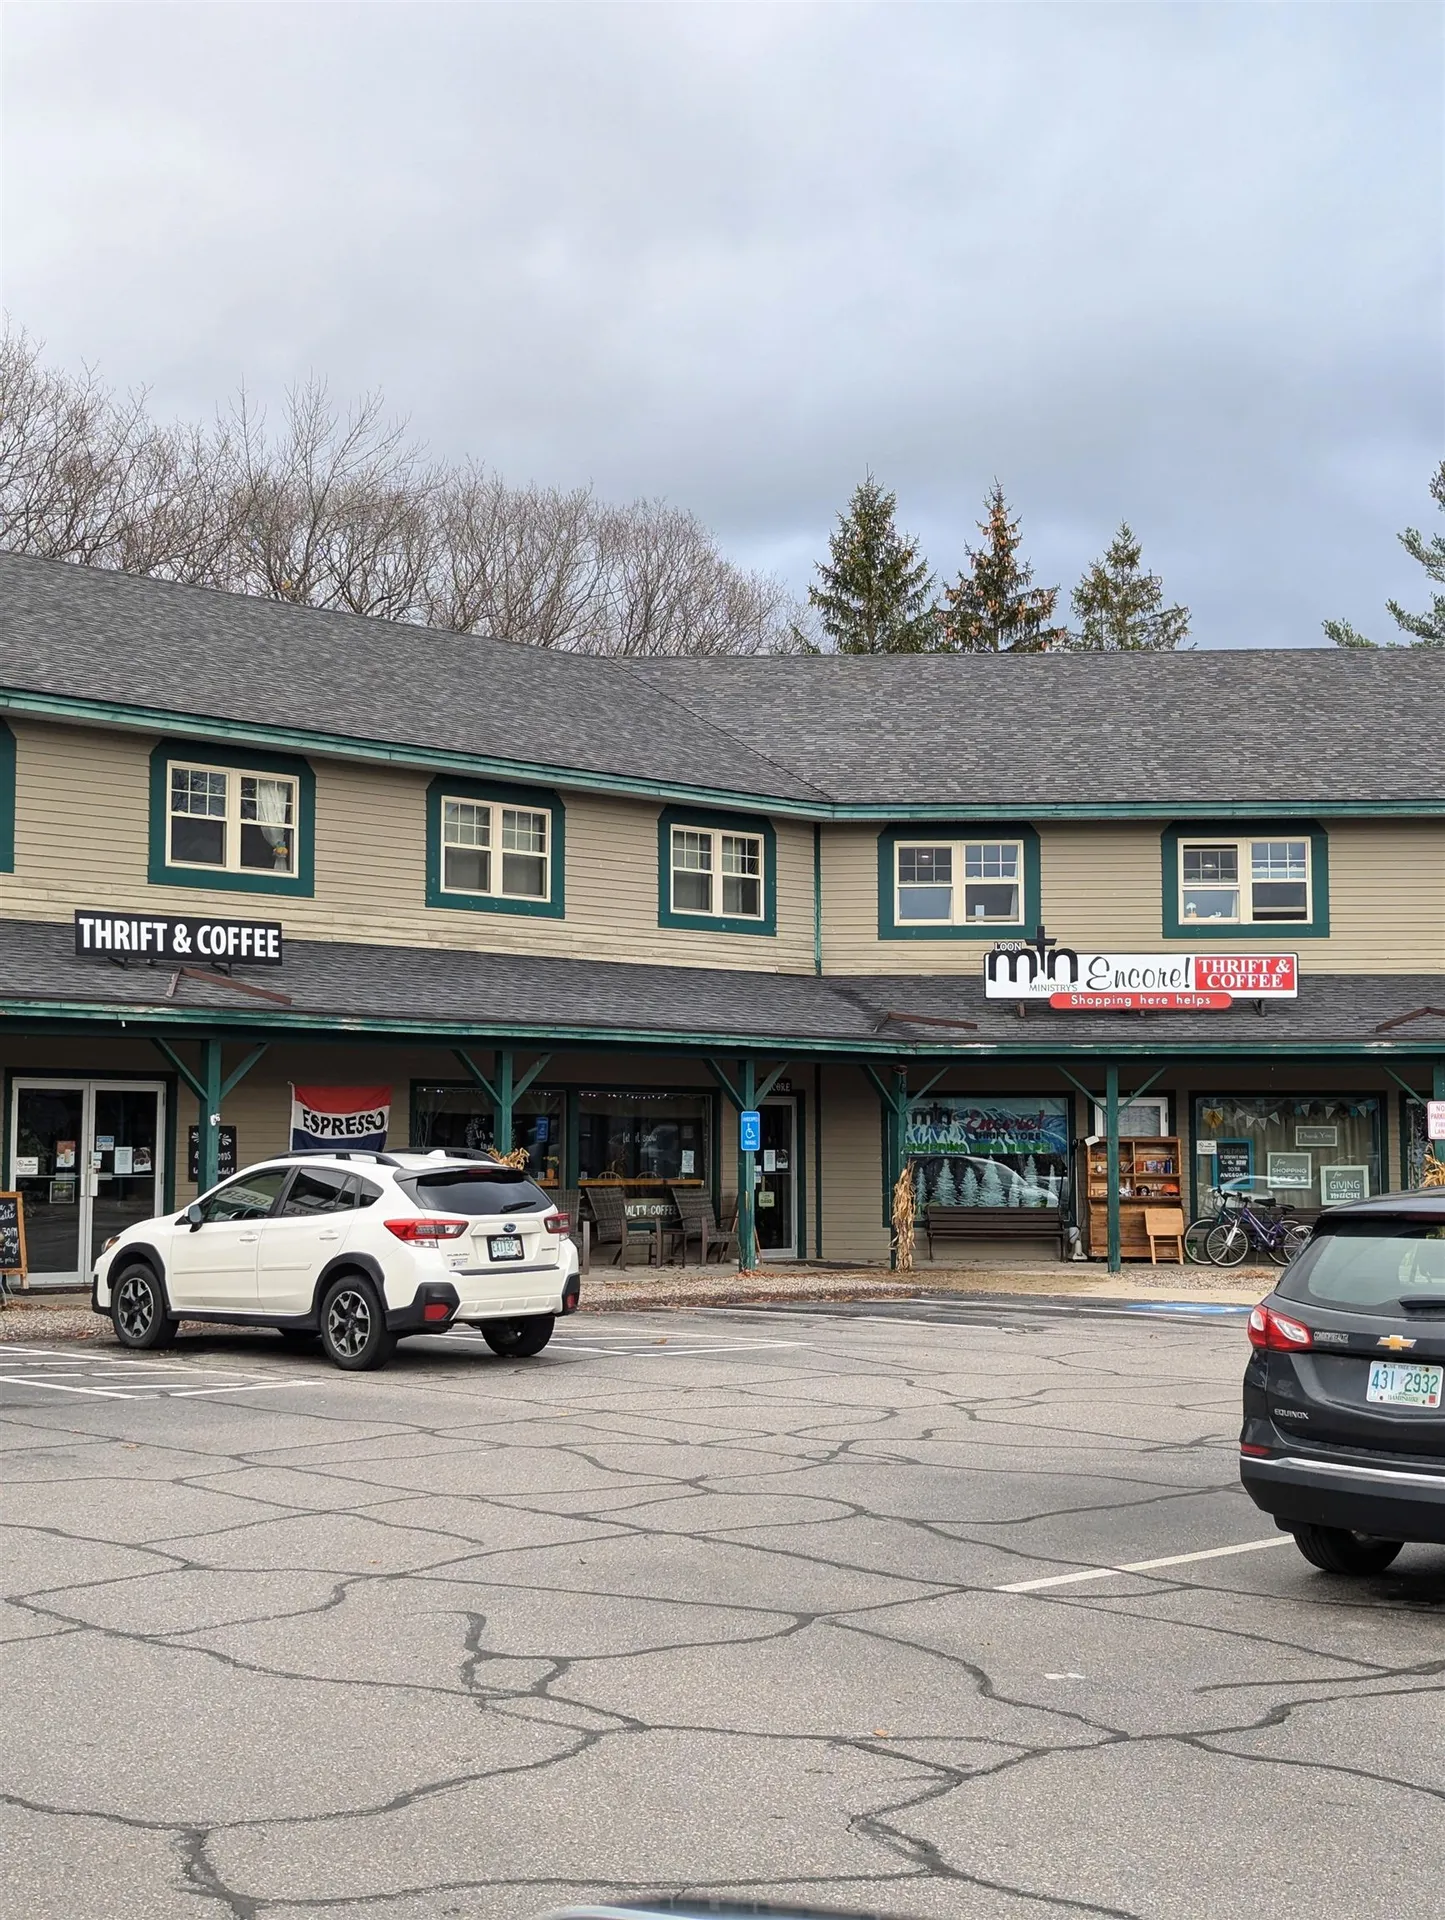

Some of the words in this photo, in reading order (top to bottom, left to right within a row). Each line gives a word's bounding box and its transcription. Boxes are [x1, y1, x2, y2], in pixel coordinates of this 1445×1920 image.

[79, 917, 168, 952] THRIFT
[172, 923, 193, 954] &
[197, 925, 280, 958] COFFEE
[994, 942, 1023, 951] LOON
[1199, 958, 1271, 973] THRIFT
[1275, 958, 1292, 973] &
[1086, 955, 1191, 991] Encore!
[1206, 973, 1284, 988] COFFEE
[1028, 983, 1079, 993] MINISTRY'S
[1071, 994, 1132, 1007] Shopping
[1139, 994, 1168, 1005] here
[1176, 994, 1211, 1007] helps
[770, 1082, 791, 1092] CORE
[302, 1109, 385, 1136] ESPRESSO
[1329, 1180, 1361, 1189] GIVING
[650, 1204, 677, 1216] COFFEE
[1371, 1369, 1395, 1390] 431
[1404, 1372, 1439, 1395] 2932
[1274, 1408, 1309, 1420] EQUINOX
